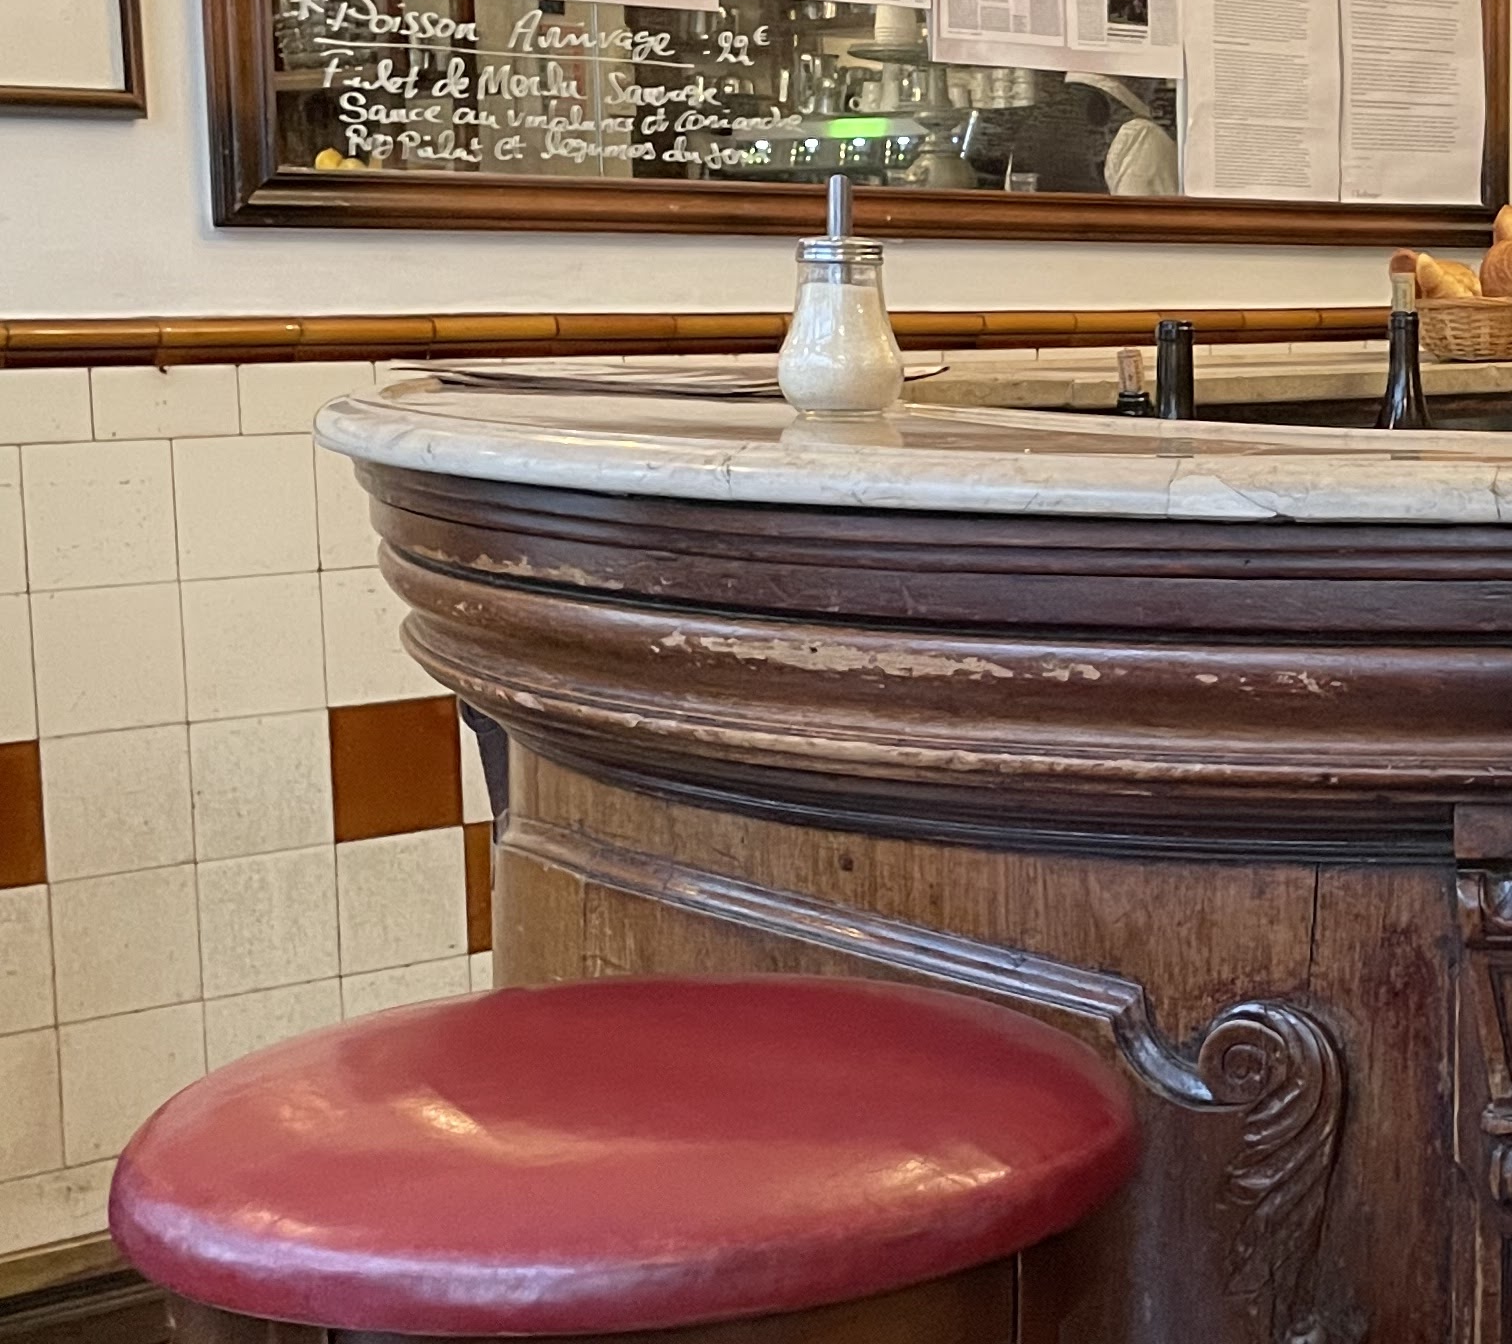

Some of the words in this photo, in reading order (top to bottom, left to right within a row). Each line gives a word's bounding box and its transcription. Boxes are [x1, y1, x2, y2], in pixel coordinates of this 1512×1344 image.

[431, 56, 470, 99] de
[338, 90, 444, 125] Sauce
[452, 106, 501, 129] au
[640, 107, 670, 135] et
[662, 134, 703, 165] du
